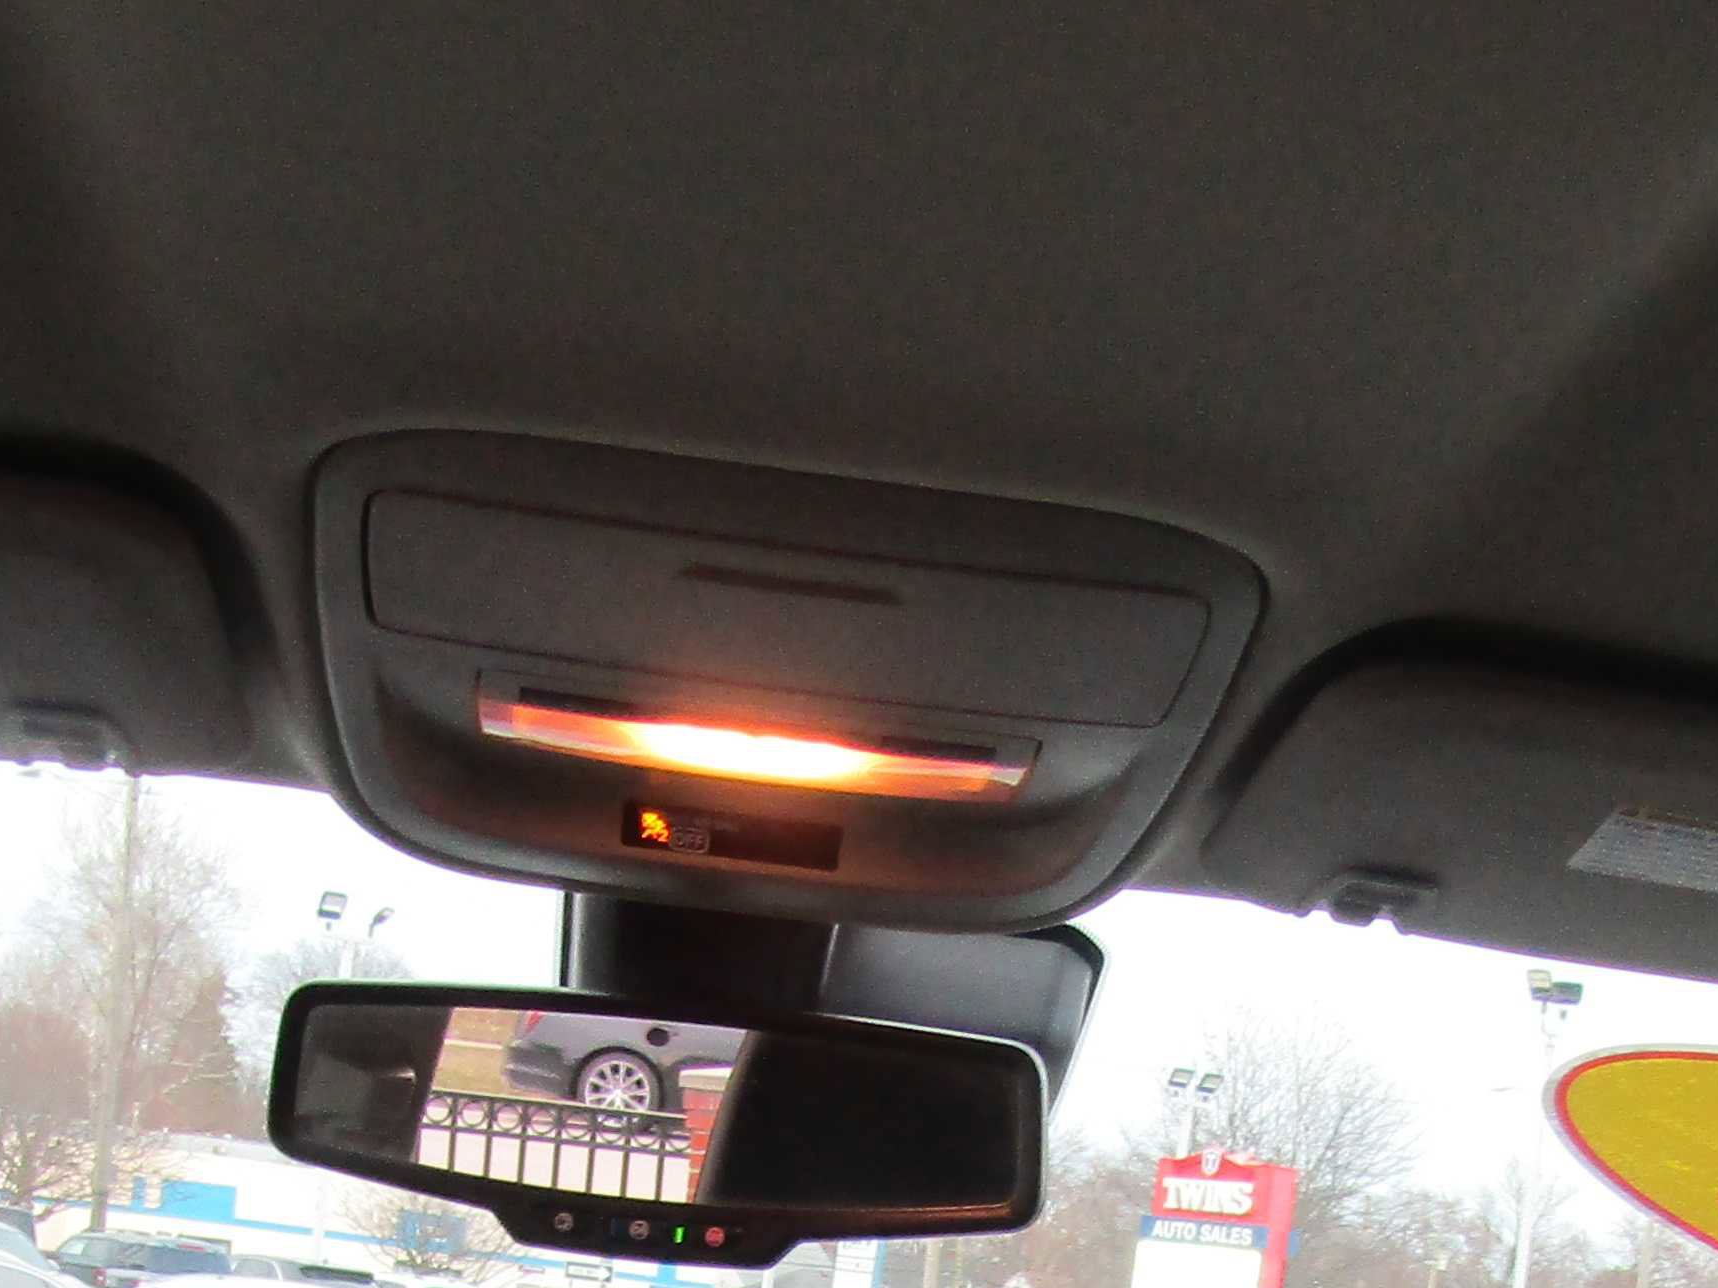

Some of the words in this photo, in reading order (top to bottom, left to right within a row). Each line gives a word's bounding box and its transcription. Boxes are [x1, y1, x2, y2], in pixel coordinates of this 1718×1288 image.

[1162, 1177, 1255, 1216] TWINS
[1151, 1220, 1197, 1240] AUTO
[1199, 1222, 1253, 1246] SALES
